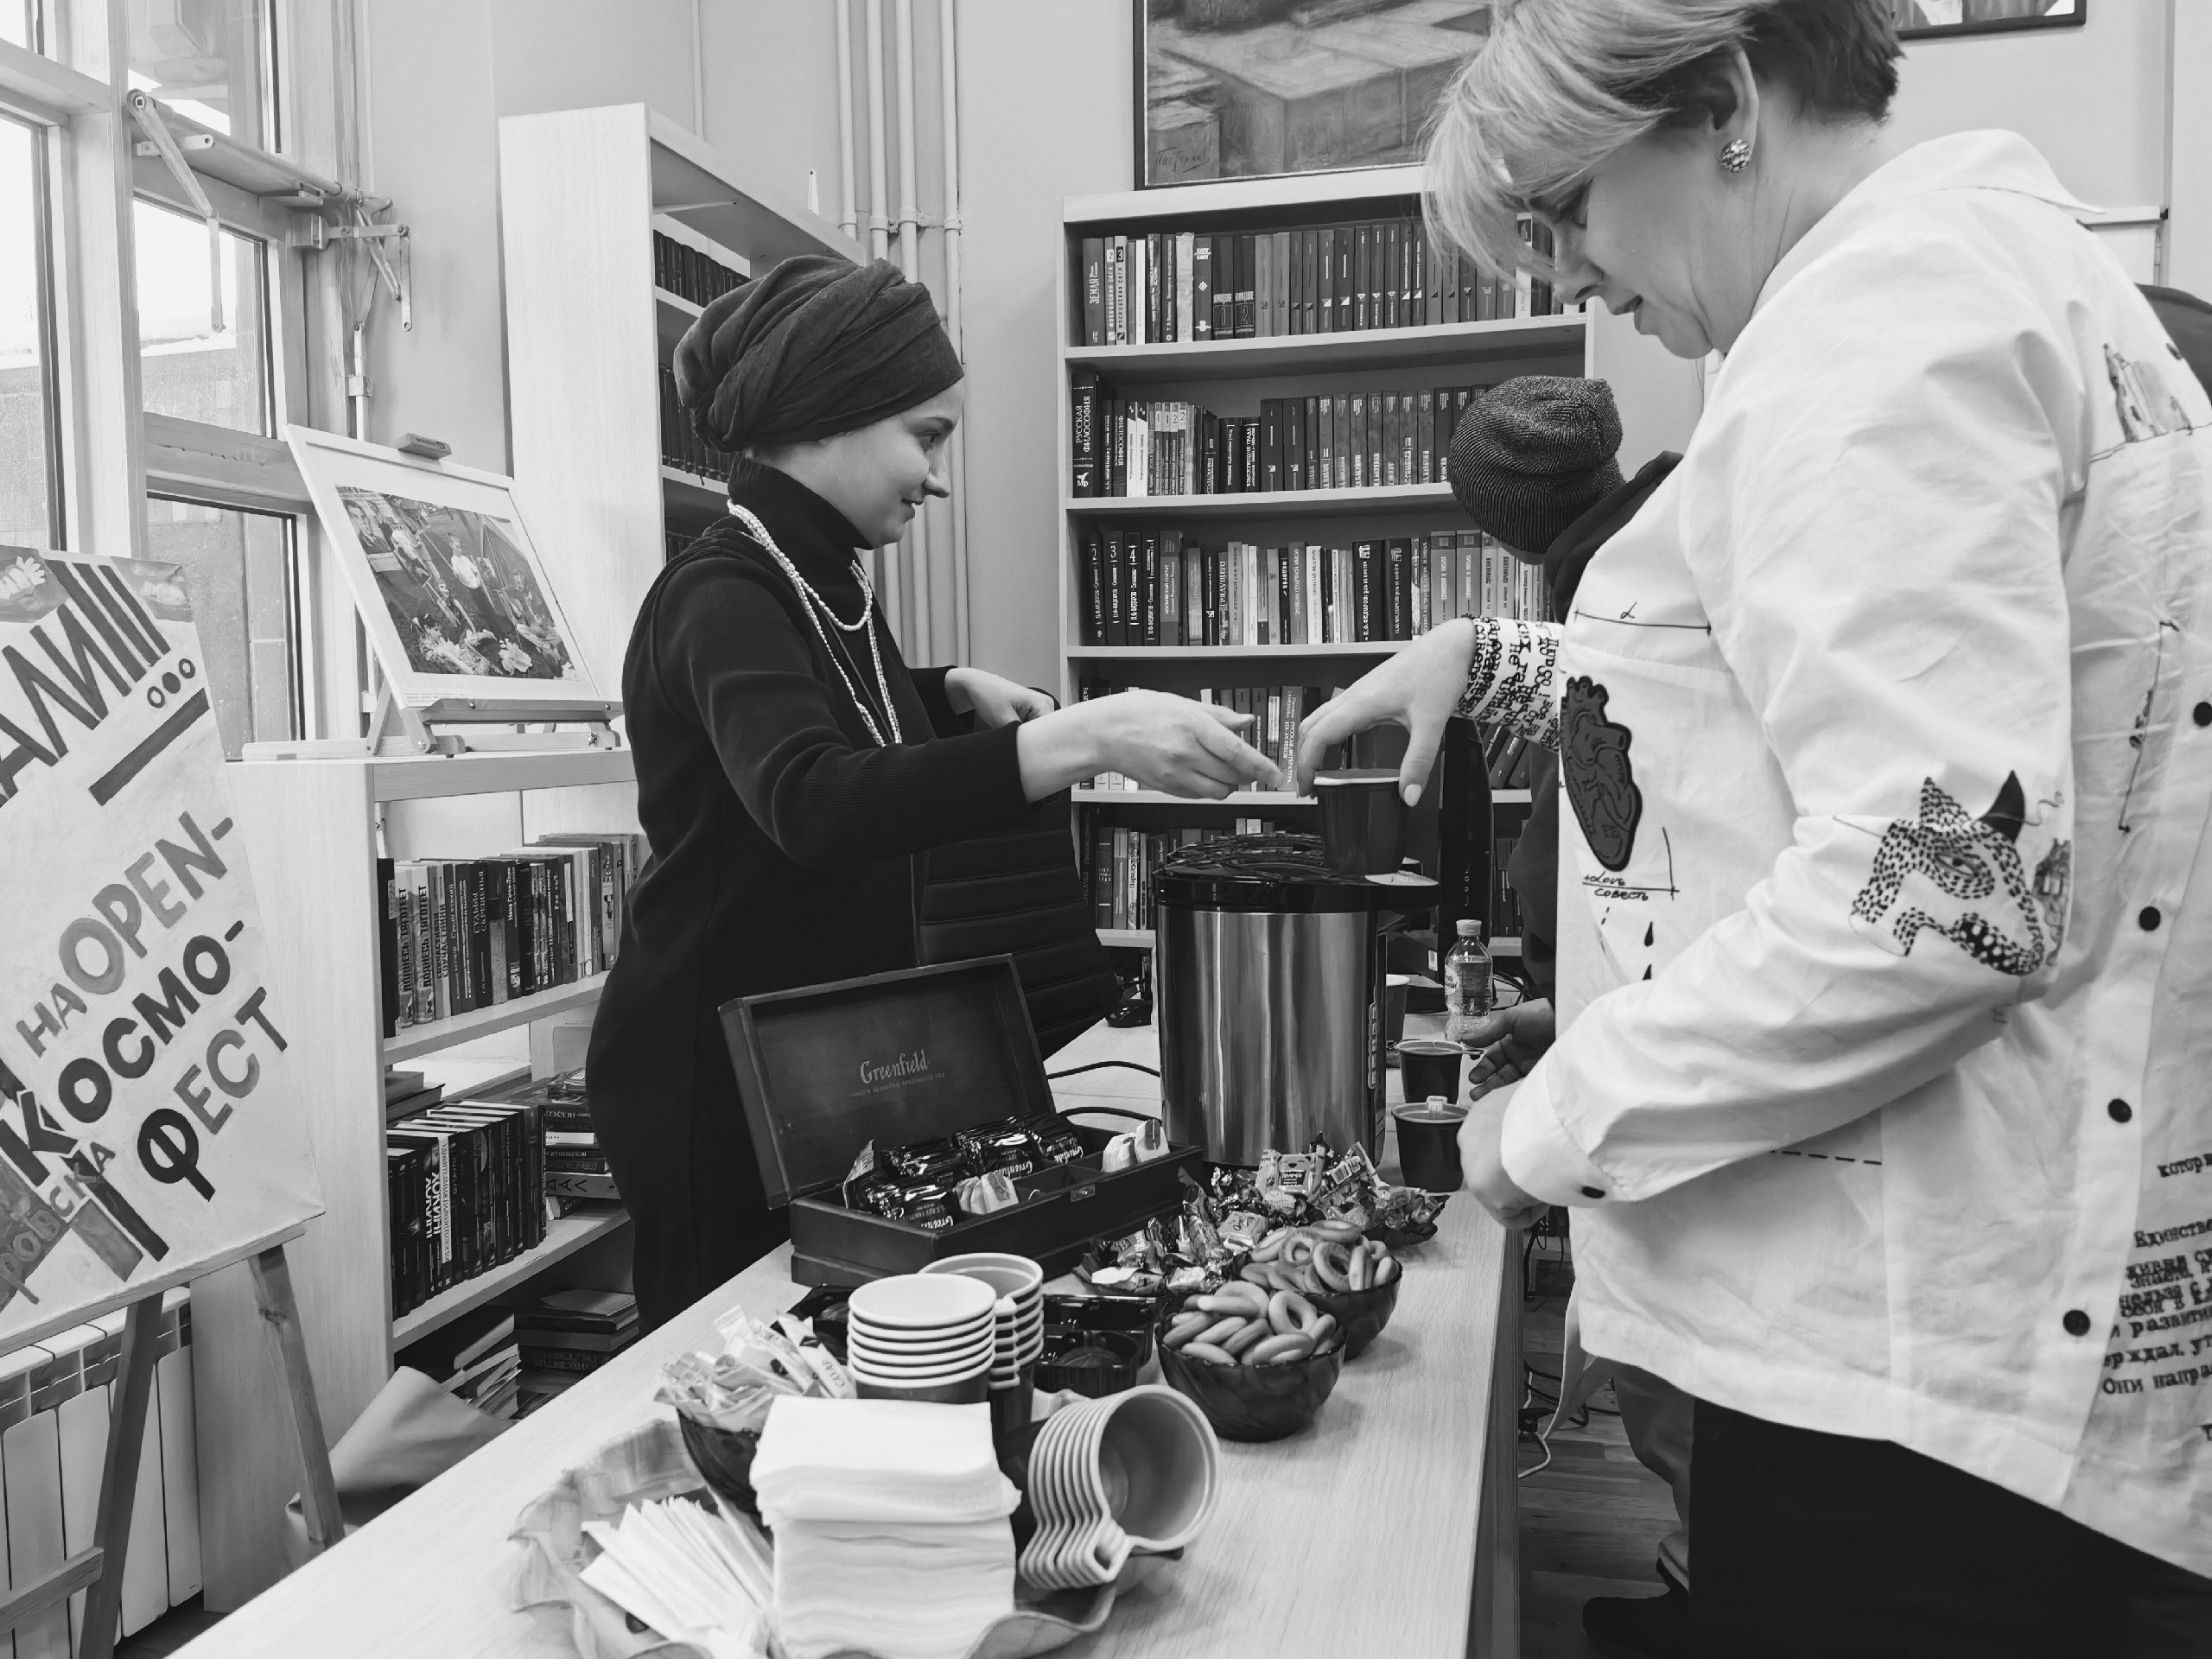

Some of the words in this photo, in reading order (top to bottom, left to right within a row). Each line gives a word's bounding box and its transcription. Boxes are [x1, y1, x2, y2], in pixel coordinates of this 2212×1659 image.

[1090, 548, 1097, 561] 2
[1110, 545, 1116, 558] 3
[1129, 549, 1136, 563] 4
[398, 888, 410, 939] ТЯГОТЕЕТ
[418, 886, 429, 934] ТЯГОТЕЕТ
[421, 938, 432, 988] ДОДНЕСЬ
[439, 904, 448, 978] СОУЧАСТНИКИ
[400, 942, 412, 992] ДОДНЕСЬ
[860, 1049, 931, 1084] Greenfield
[137, 986, 289, 1202] ФЕСТ
[432, 1173, 442, 1234] ХОКИНГ
[2152, 1364, 2212, 1389] напра
